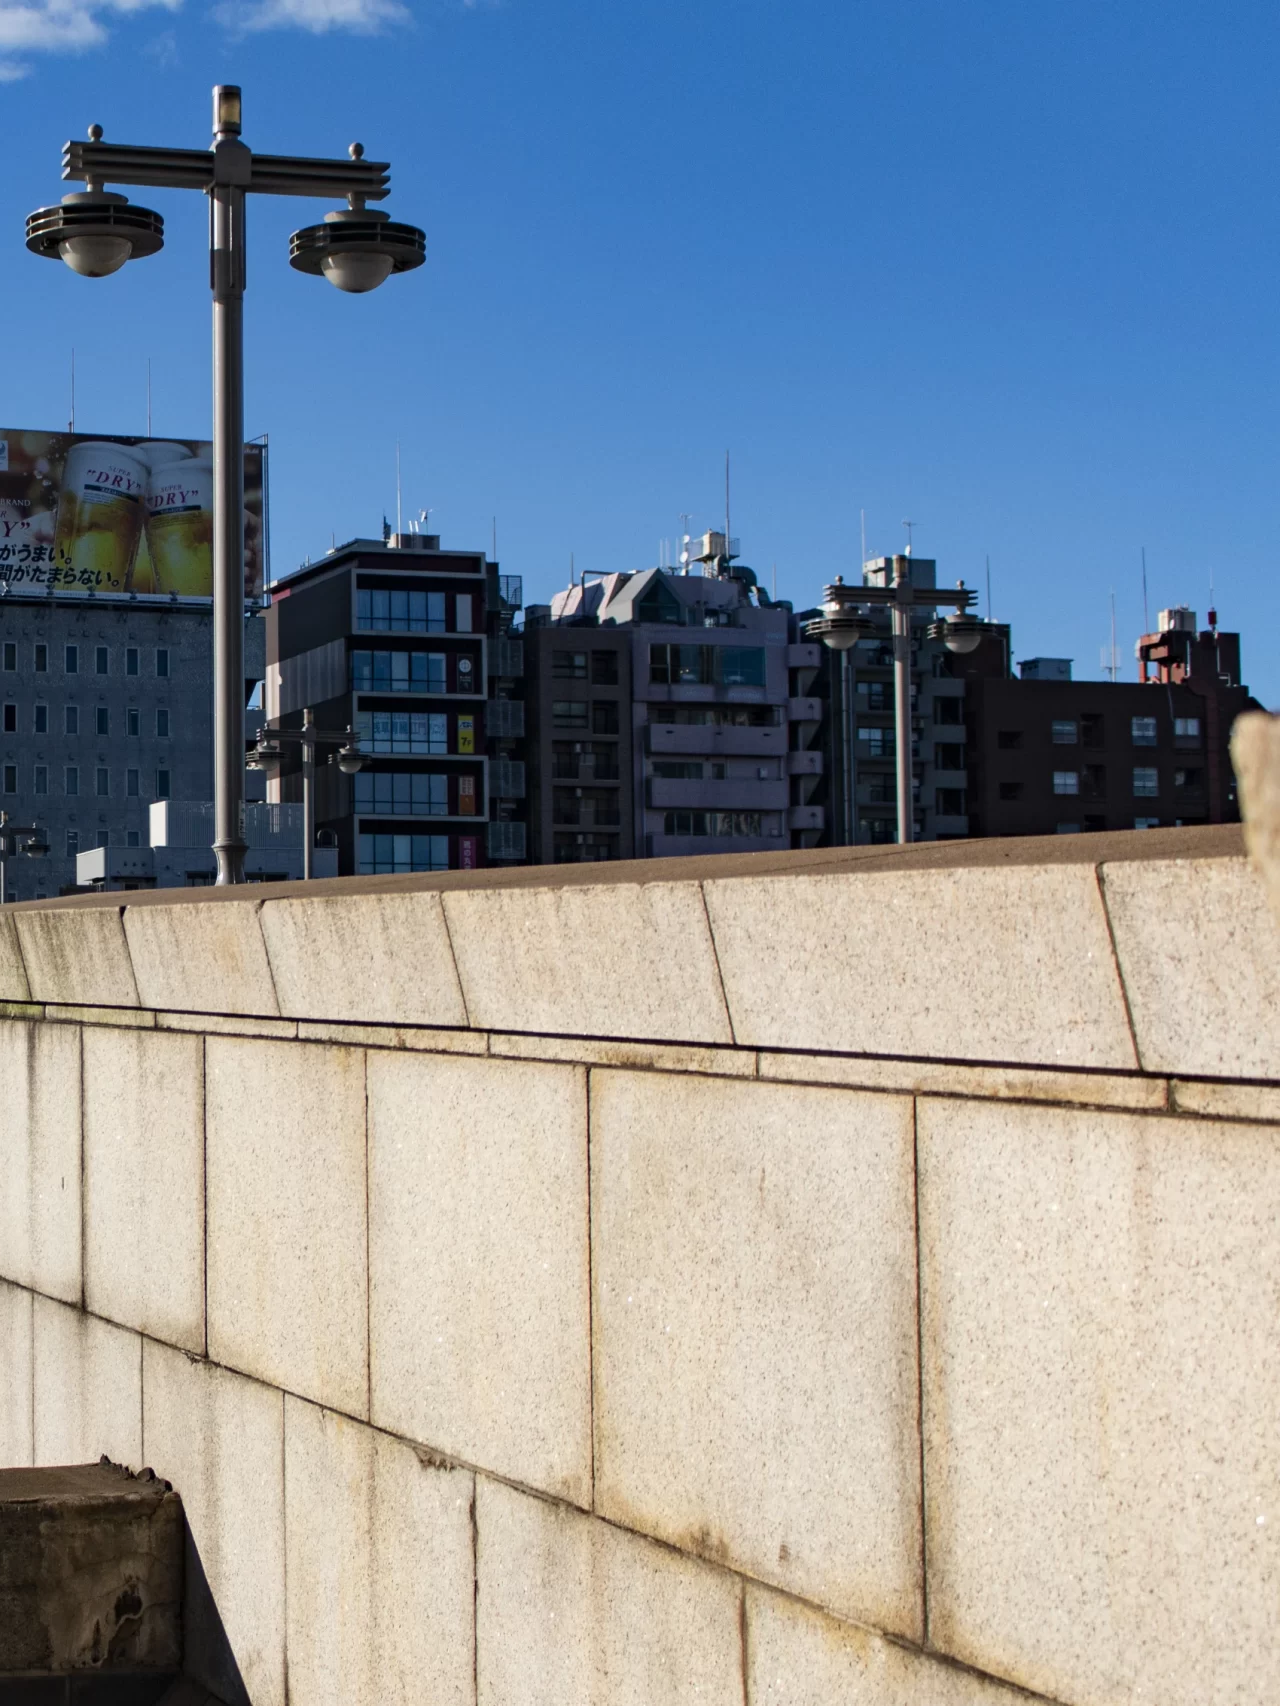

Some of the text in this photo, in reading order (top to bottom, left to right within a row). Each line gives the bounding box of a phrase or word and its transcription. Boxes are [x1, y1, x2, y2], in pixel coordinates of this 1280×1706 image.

[108, 465, 131, 477] SUPER
[161, 484, 182, 492] SUPER
[0, 498, 31, 507] BRAND
